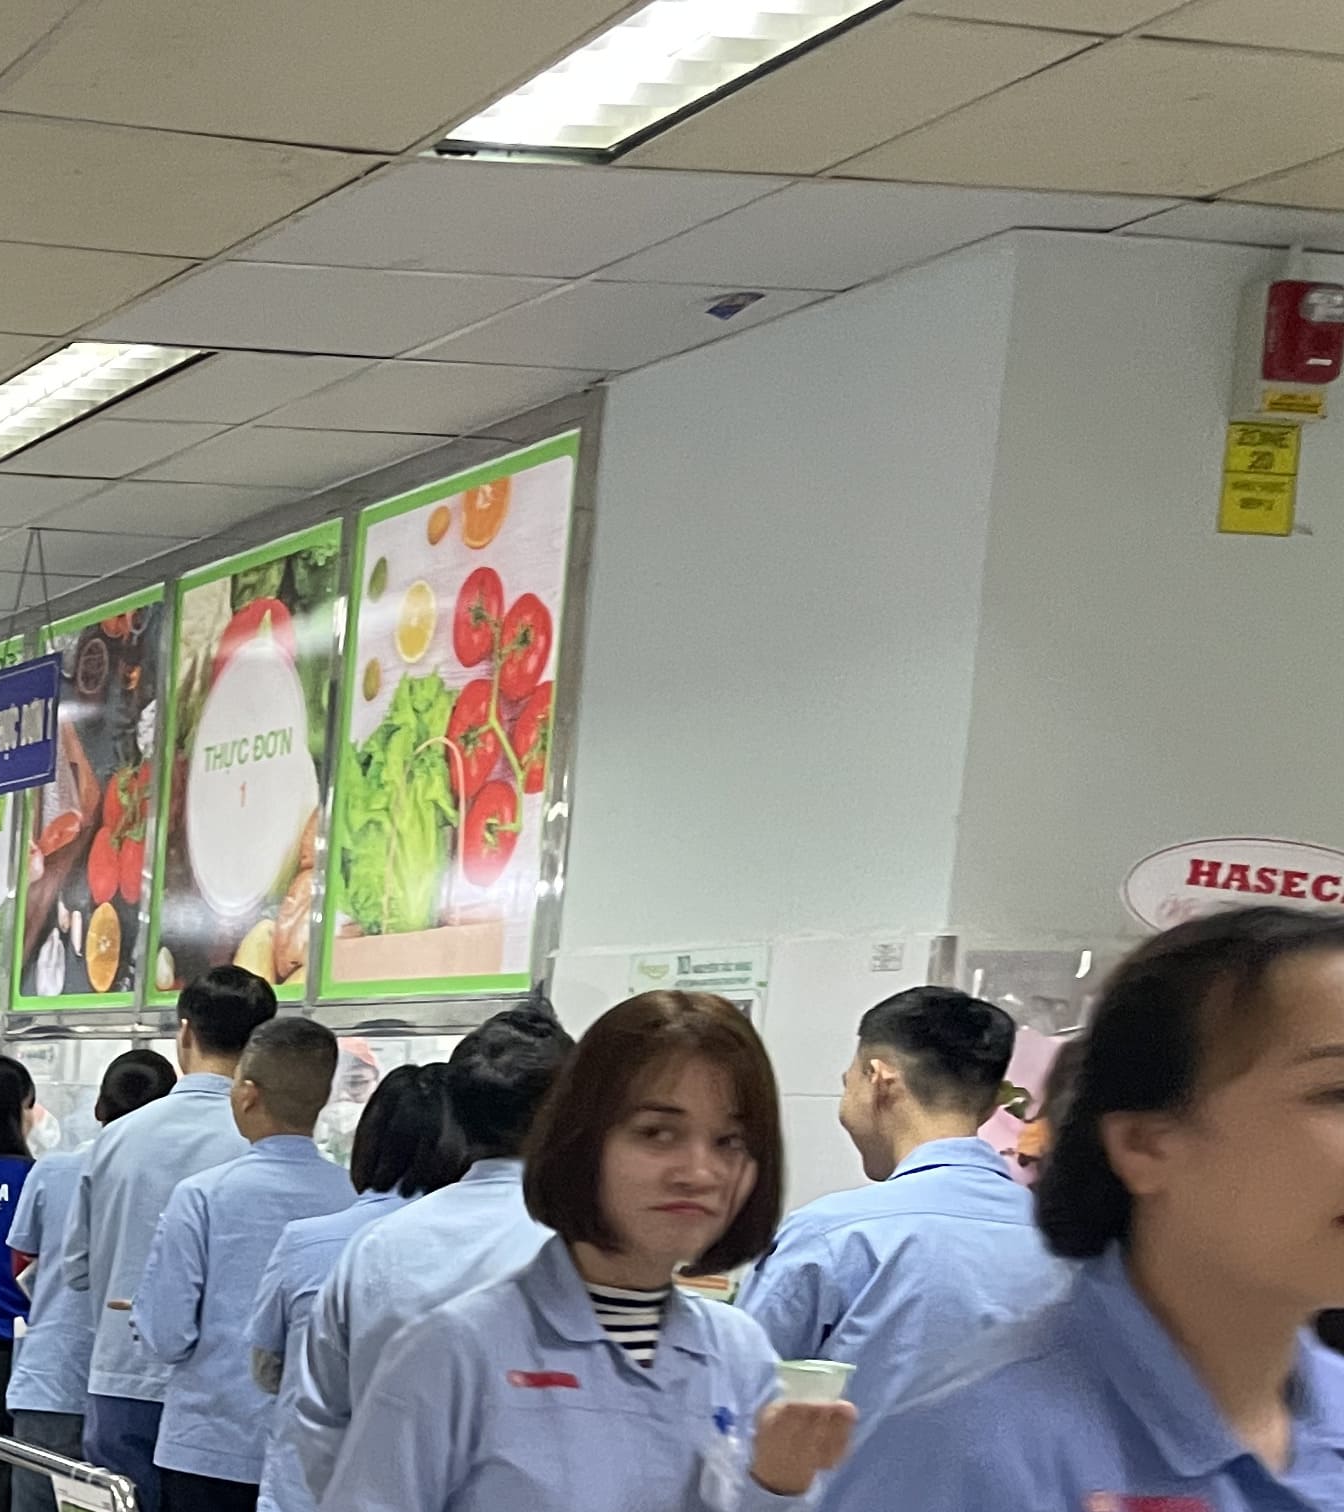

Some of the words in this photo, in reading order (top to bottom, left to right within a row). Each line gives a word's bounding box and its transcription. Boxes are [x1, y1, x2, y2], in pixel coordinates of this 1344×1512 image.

[204, 738, 249, 774] THỰC
[253, 726, 294, 762] ĐƠN
[239, 781, 248, 808] 1
[1185, 858, 1344, 904] HASEC
